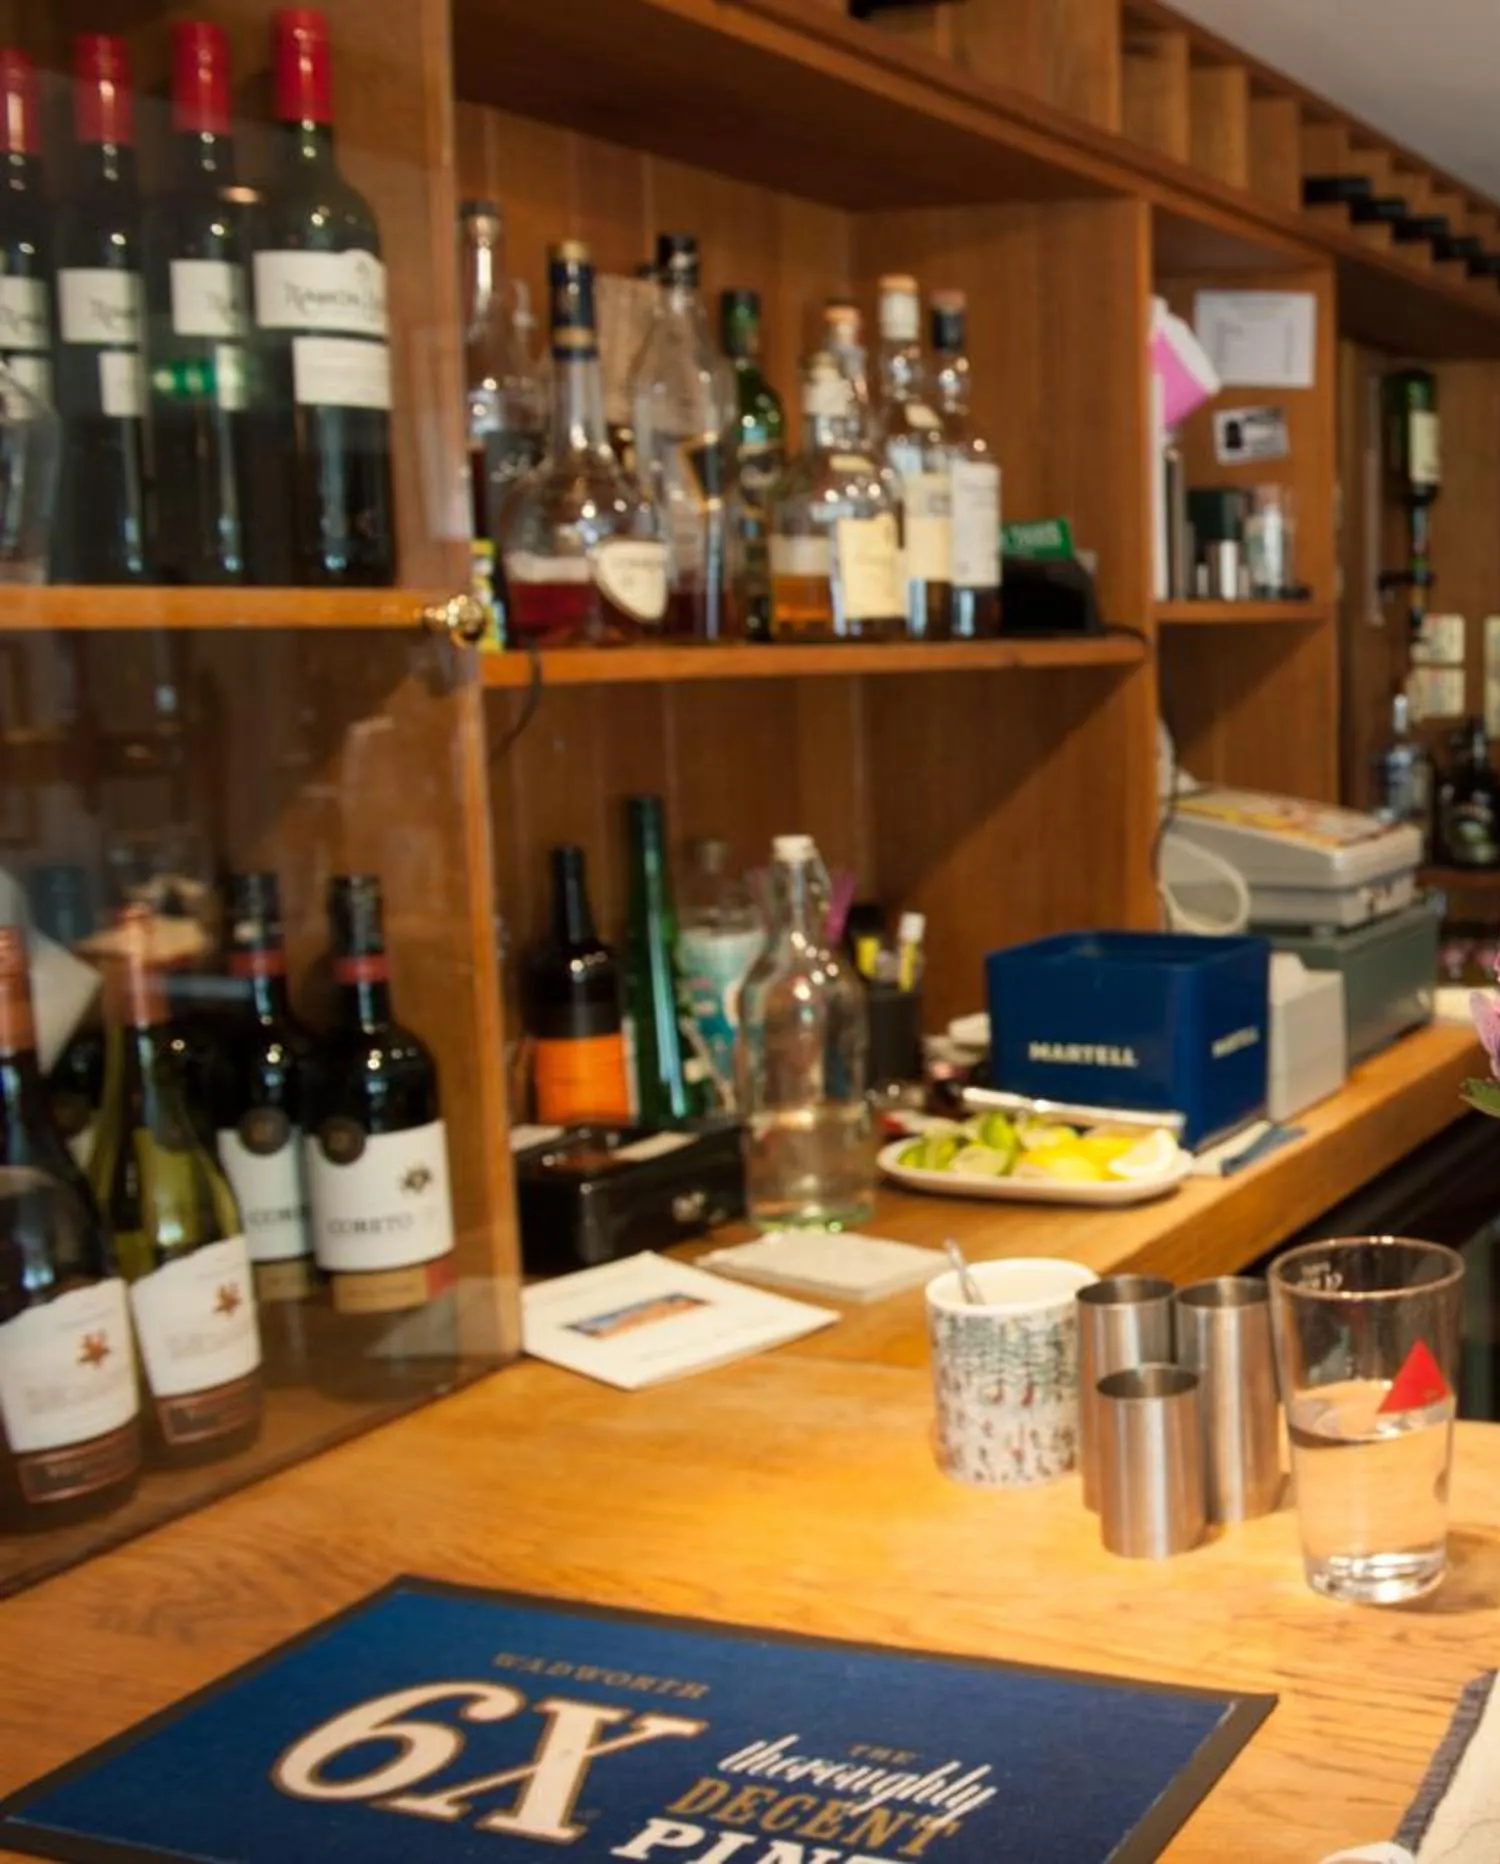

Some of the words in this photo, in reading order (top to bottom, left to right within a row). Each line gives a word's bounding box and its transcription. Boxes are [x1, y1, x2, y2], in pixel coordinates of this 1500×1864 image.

[1028, 1041, 1138, 1068] MARTELL
[492, 1652, 710, 1699] WADWORTH
[269, 1681, 706, 1844] 6X
[847, 1743, 918, 1765] THE
[717, 1733, 998, 1831] thoroughly
[610, 1817, 916, 1864] PIN
[664, 1777, 964, 1857] DECENT
